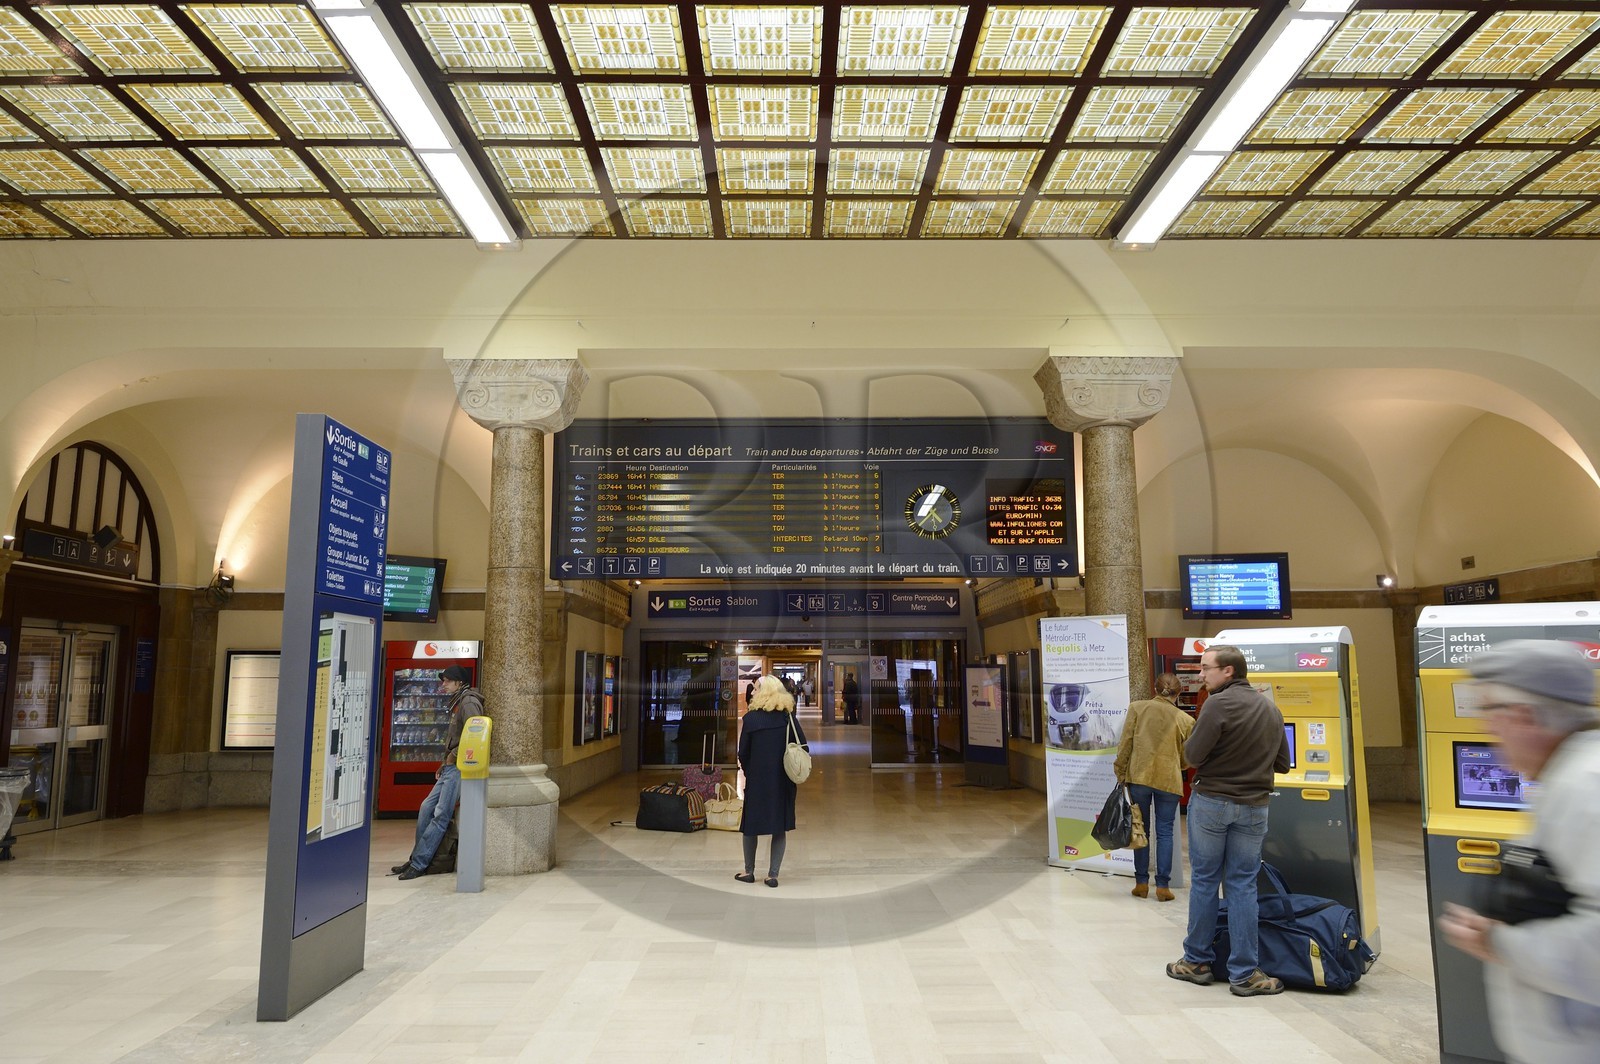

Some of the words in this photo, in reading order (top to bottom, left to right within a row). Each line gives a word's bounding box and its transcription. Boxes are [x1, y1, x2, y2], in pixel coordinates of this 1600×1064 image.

[334, 428, 356, 451] Sortie
[570, 444, 612, 456] Trains
[616, 446, 629, 456] et
[633, 448, 664, 456] cars
[665, 448, 682, 456] au
[688, 444, 732, 458] départ
[745, 448, 768, 456] Train
[771, 448, 788, 456] and
[791, 448, 807, 456] bus
[810, 447, 859, 459] departures
[867, 447, 902, 456] Abfahrt
[906, 447, 922, 455] der
[925, 446, 948, 458] Züge
[951, 446, 968, 455] und
[971, 446, 1000, 454] Busse
[332, 470, 344, 484] Billets
[330, 494, 348, 510] Accueil
[329, 523, 342, 536] Objets
[343, 529, 358, 541] trouvés
[71, 547, 76, 557] A
[92, 547, 97, 555] P
[327, 546, 342, 559] Groupe
[346, 551, 358, 563] Junior
[609, 564, 613, 572] 1
[628, 564, 636, 572] A
[700, 564, 711, 573] La
[716, 564, 734, 573] voie
[738, 565, 752, 573] est
[756, 564, 792, 576] indiquée
[796, 564, 806, 573] 20
[810, 564, 846, 573] minutes
[850, 564, 873, 573] avant
[877, 563, 885, 572] le
[889, 563, 918, 574] départ
[924, 563, 934, 572] du
[938, 563, 960, 572] train.
[326, 570, 344, 583] Toilettes
[689, 596, 721, 606] Sortie
[727, 596, 758, 606] Sablon
[914, 594, 945, 603] Pompidou
[834, 601, 840, 610] 2
[872, 601, 878, 609] 9
[1450, 632, 1486, 642] achat
[1089, 644, 1105, 652] Metz
[1450, 644, 1491, 653] retrait
[1299, 658, 1327, 667] SNCF
